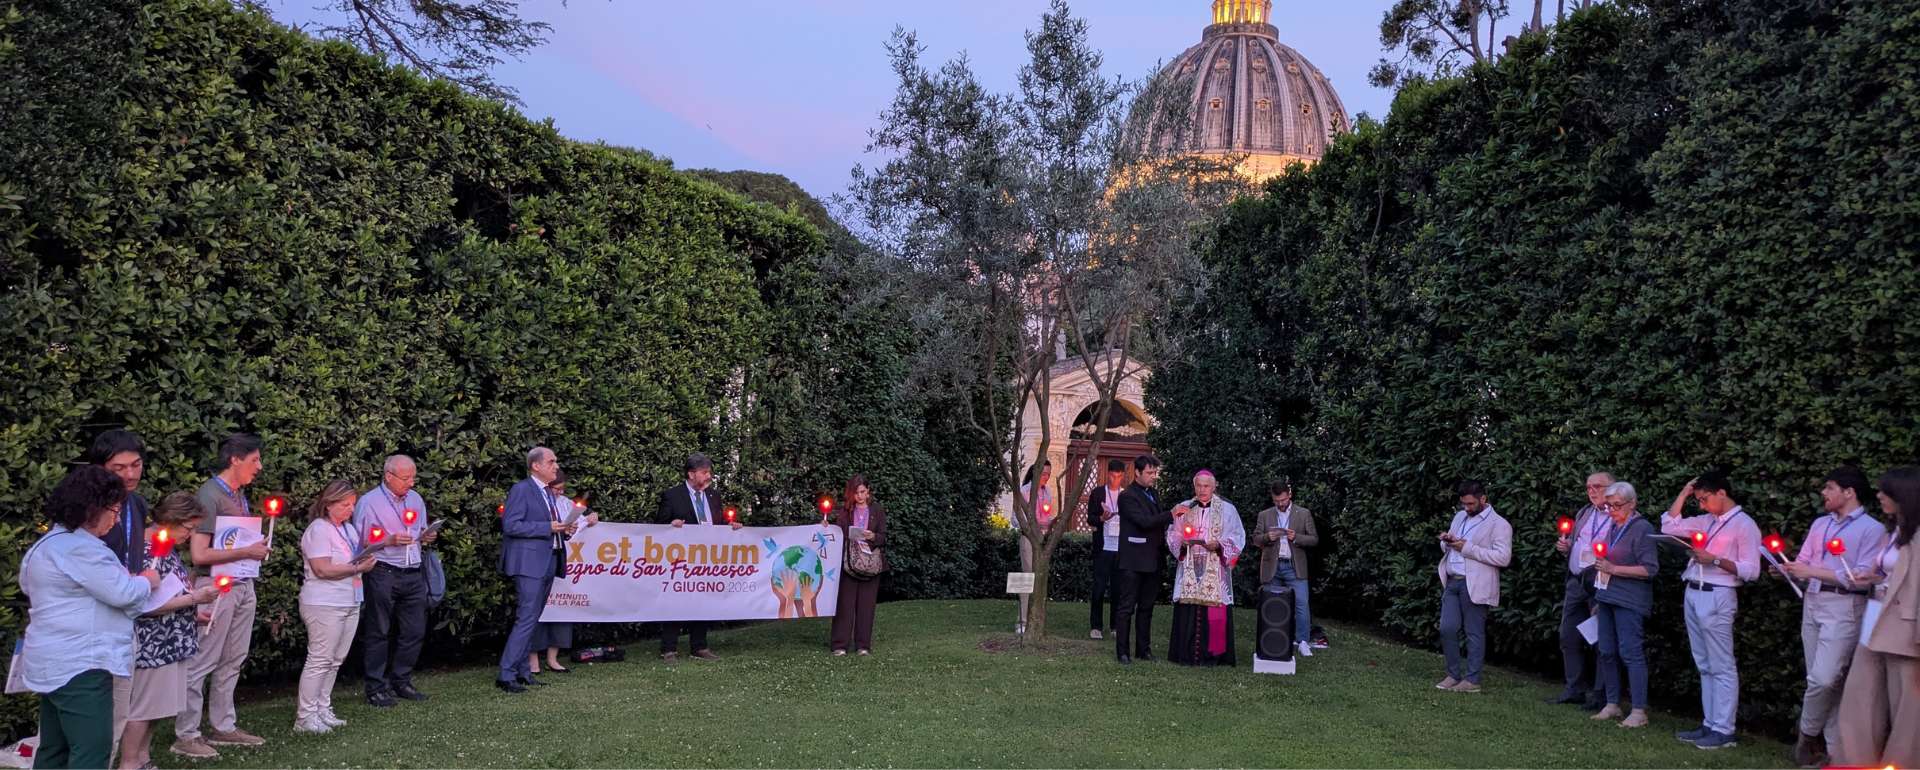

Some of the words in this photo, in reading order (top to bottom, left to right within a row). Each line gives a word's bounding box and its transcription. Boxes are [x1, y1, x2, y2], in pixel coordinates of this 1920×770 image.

[567, 542, 585, 562] x
[597, 537, 632, 563] et
[644, 535, 759, 564] bonum
[565, 563, 608, 584] egno
[610, 558, 629, 575] di
[632, 558, 667, 579] San
[670, 559, 759, 580] Francesco
[662, 582, 669, 592] 7
[673, 582, 725, 592] GIUGNO
[728, 582, 757, 592] 2026
